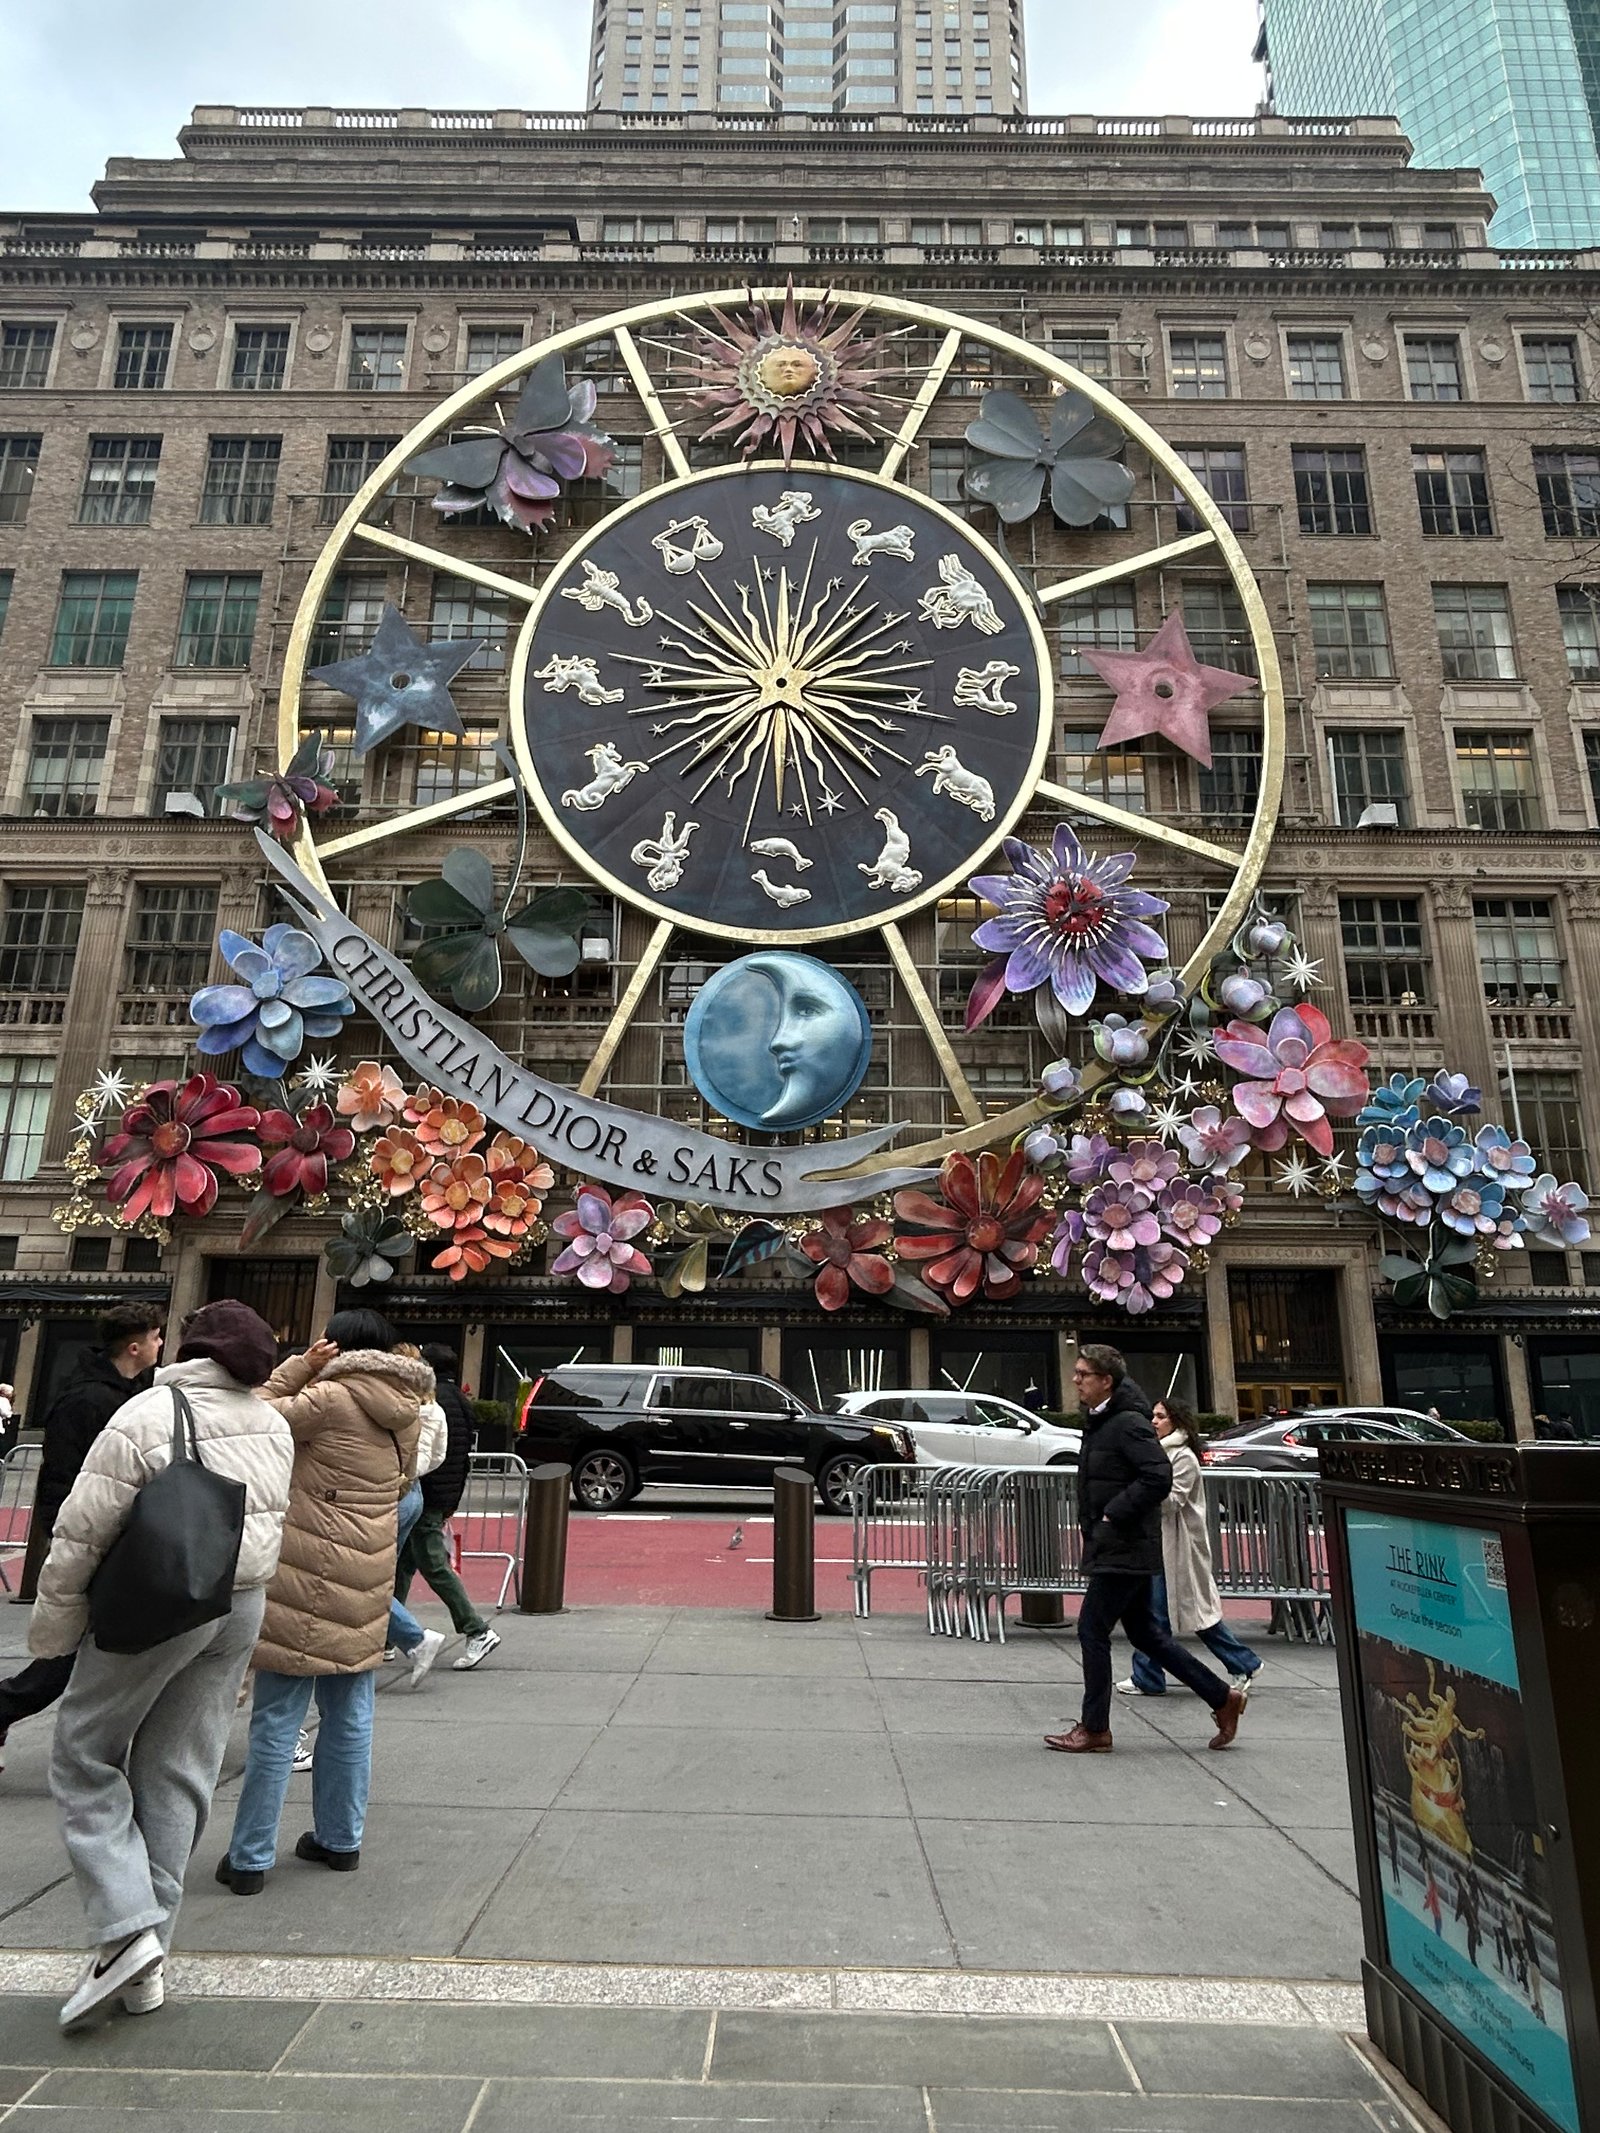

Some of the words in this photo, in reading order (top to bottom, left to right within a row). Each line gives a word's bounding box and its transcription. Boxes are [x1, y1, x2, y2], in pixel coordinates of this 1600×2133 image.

[333, 935, 519, 1108] CHRISTIAN
[518, 1088, 628, 1168] DIOR
[633, 1148, 657, 1176] &
[666, 1146, 784, 1199] SAKS
[1276, 1248, 1340, 1259] COMPANY
[1321, 1449, 1428, 1487] ROCKEFELLER
[1436, 1456, 1516, 1494] CENTER
[1389, 1545, 1412, 1573] THE
[1416, 1550, 1448, 1582] RINK
[1390, 1603, 1410, 1621] Open
[1410, 1609, 1421, 1624] for
[1422, 1614, 1435, 1629] the
[1435, 1620, 1462, 1639] season
